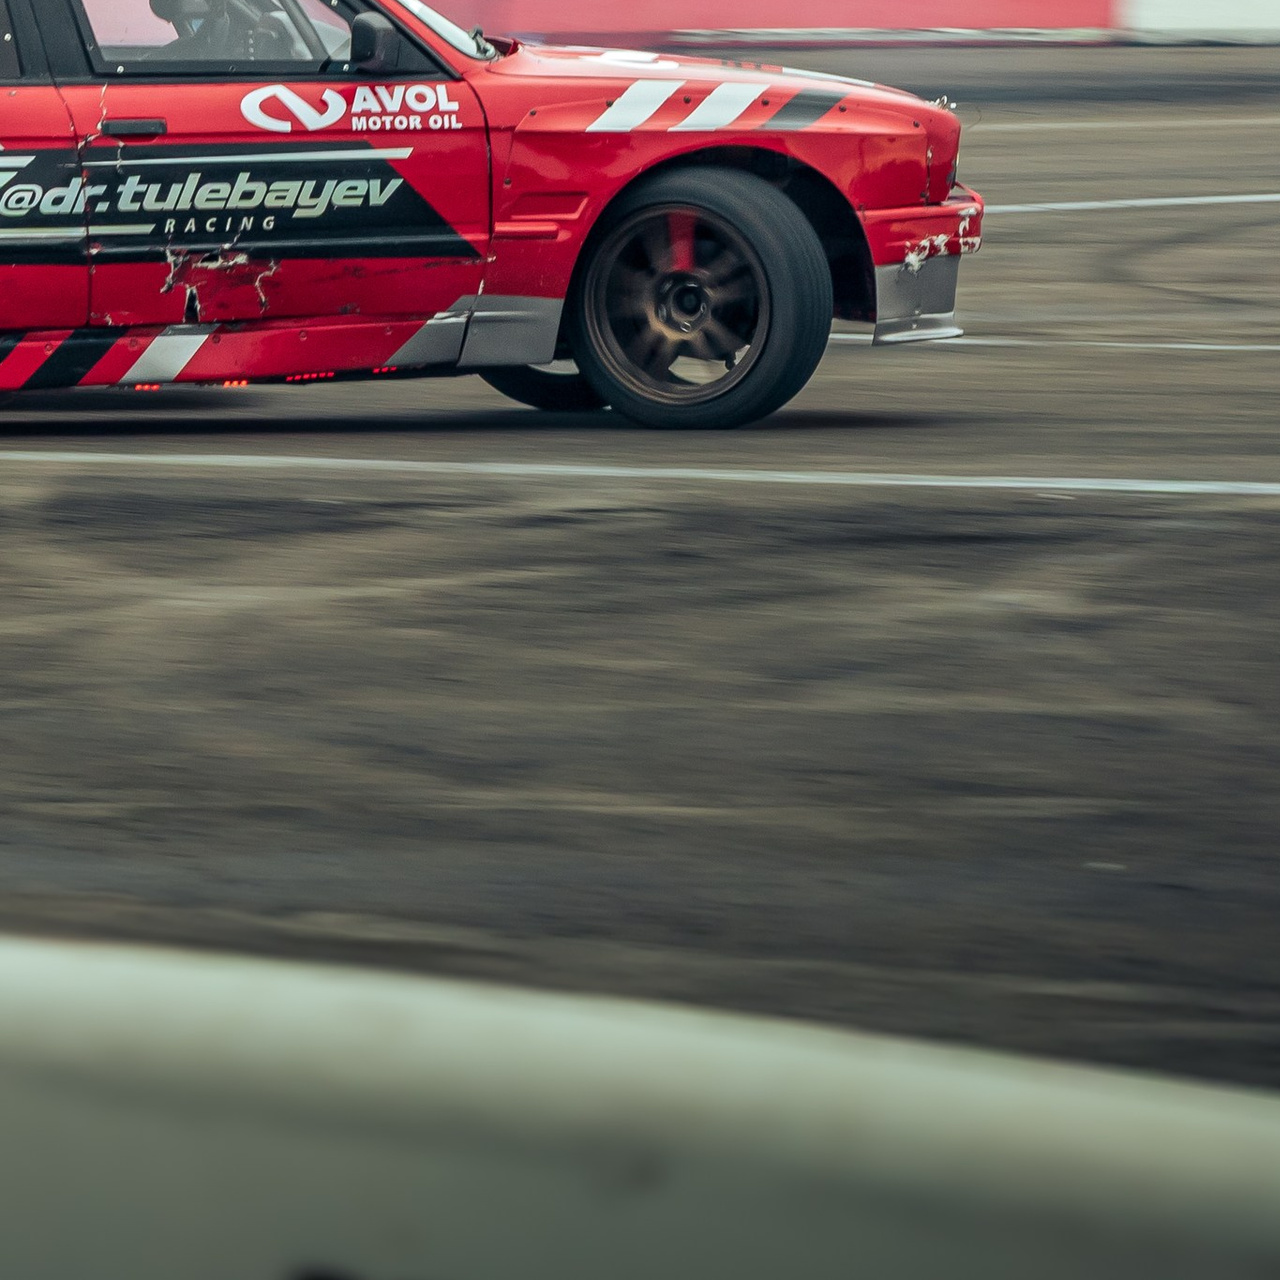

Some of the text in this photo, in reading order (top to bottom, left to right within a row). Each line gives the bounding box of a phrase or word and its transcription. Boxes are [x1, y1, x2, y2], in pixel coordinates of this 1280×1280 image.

[351, 84, 460, 114] AVOL
[351, 114, 463, 131] MOTOR OIL
[164, 216, 276, 233] RACING
